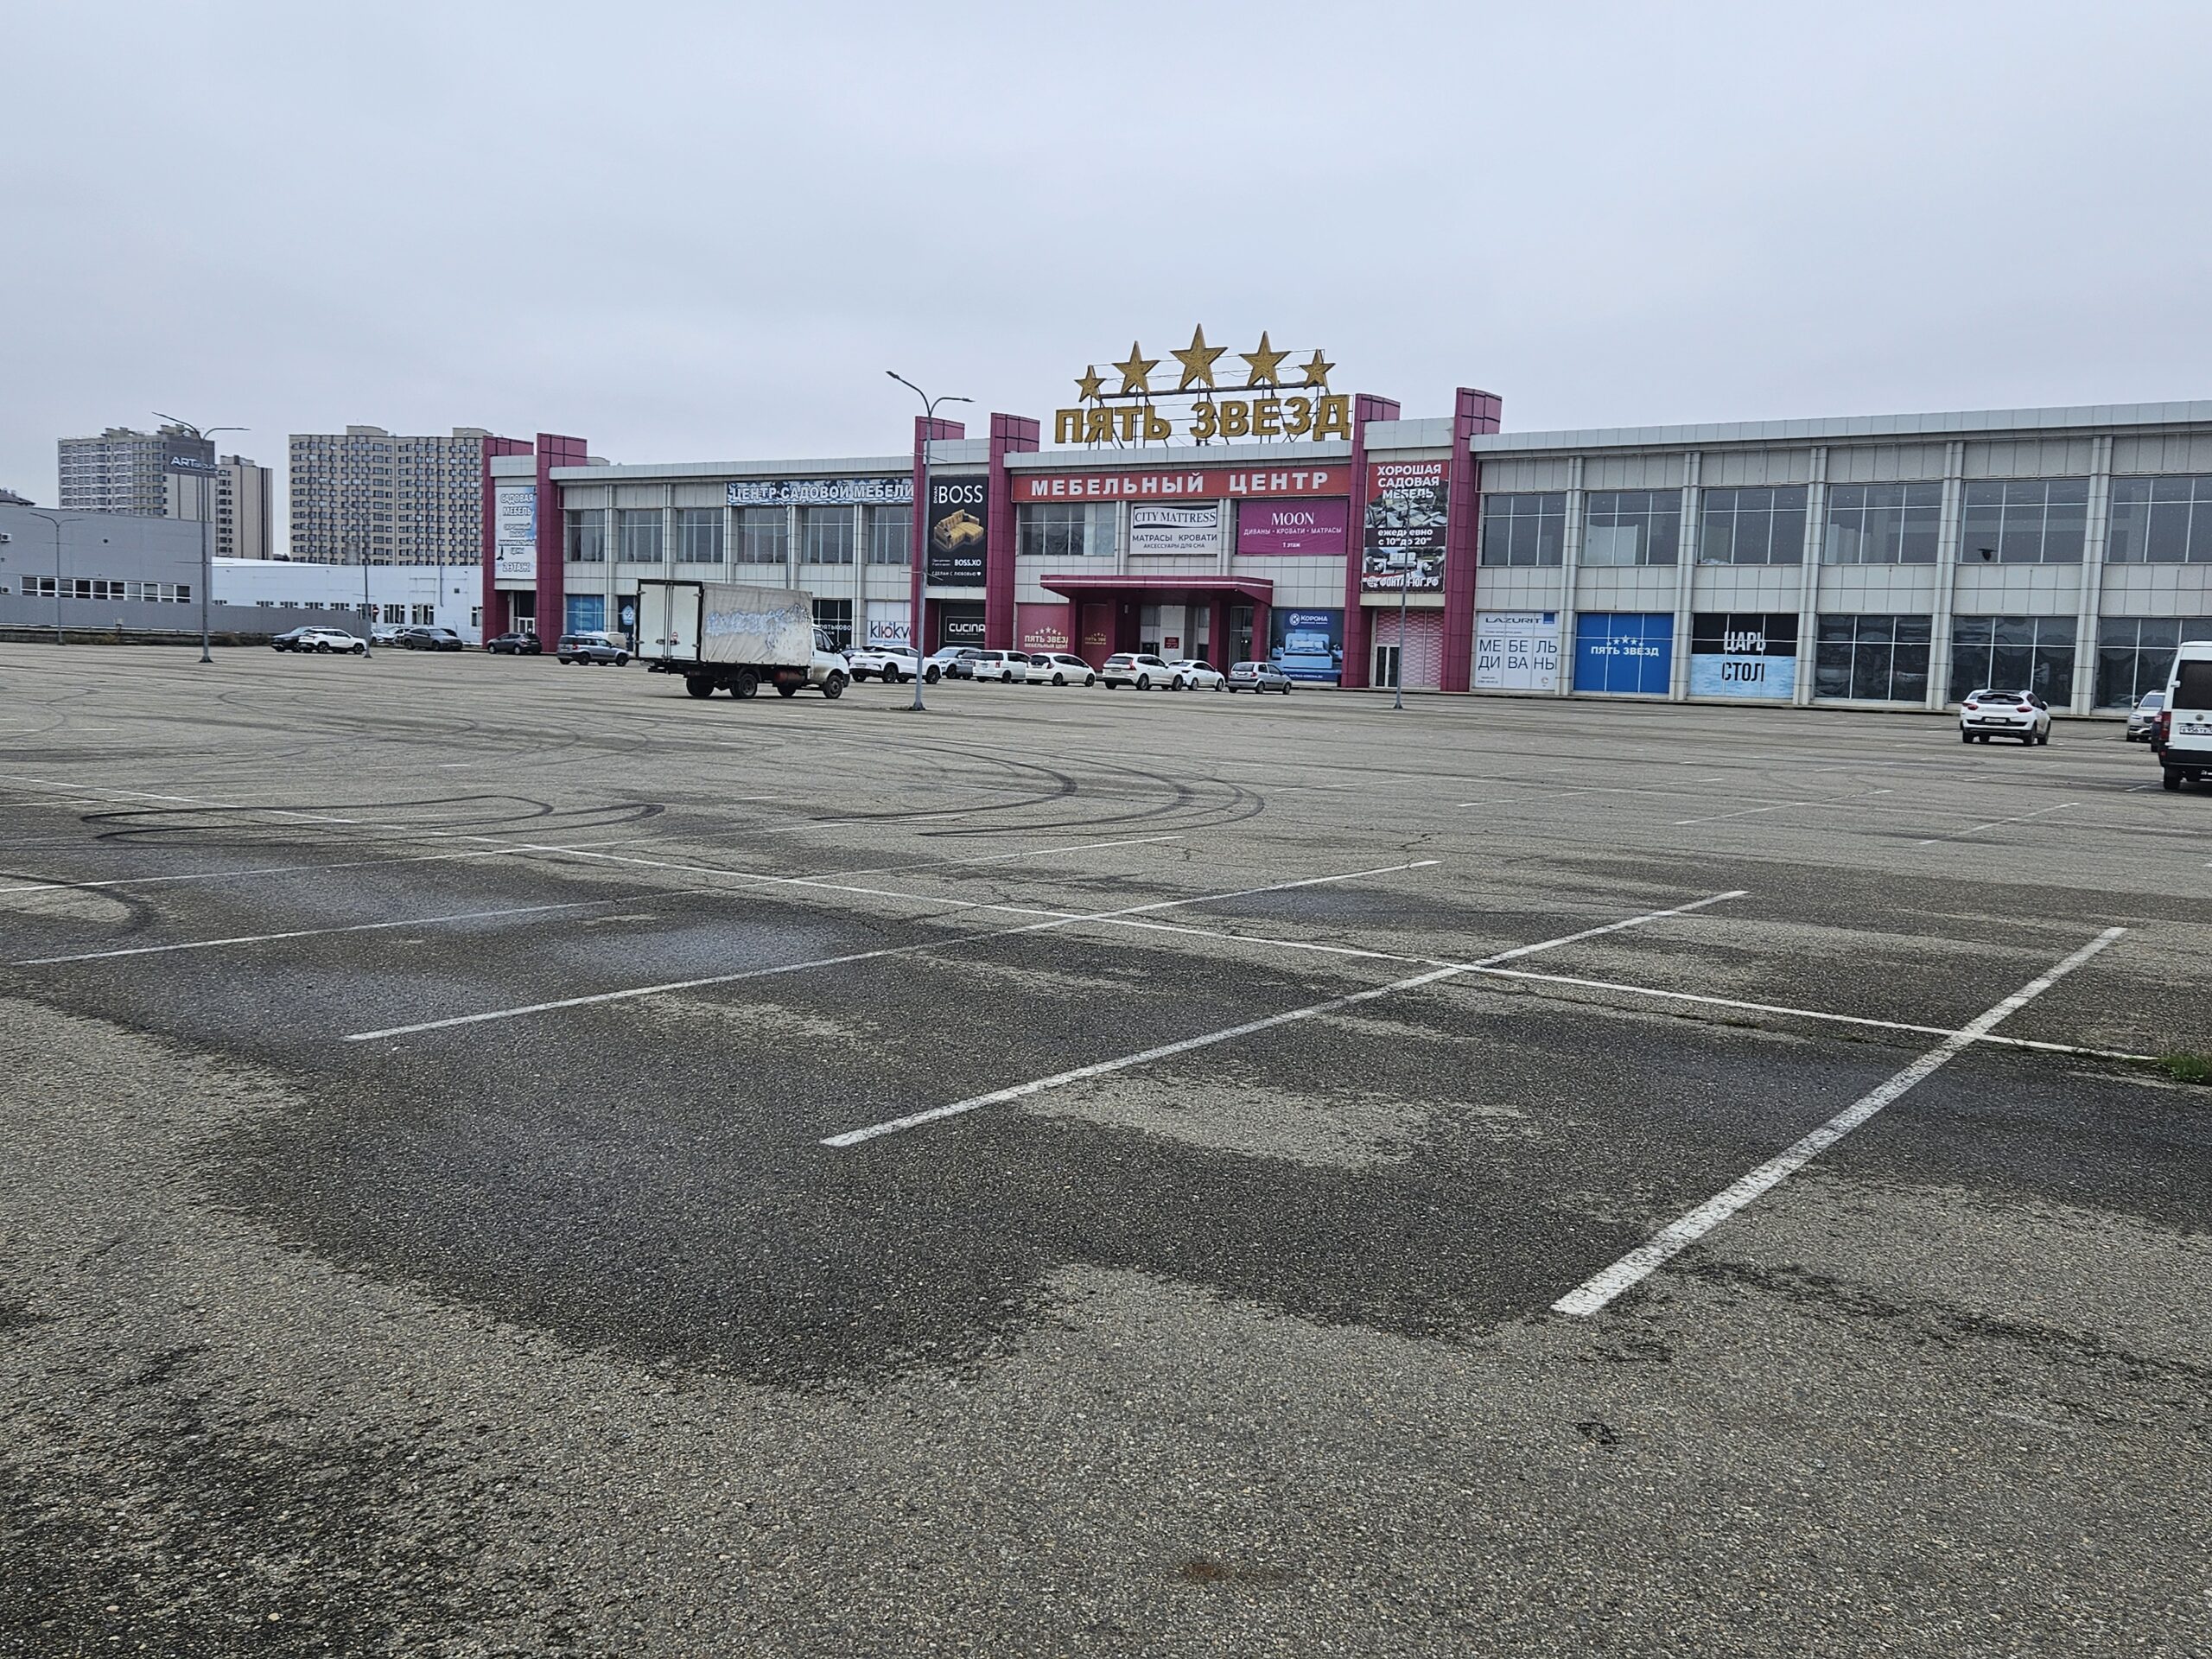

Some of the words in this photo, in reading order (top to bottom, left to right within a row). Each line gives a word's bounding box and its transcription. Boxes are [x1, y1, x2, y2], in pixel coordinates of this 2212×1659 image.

[1055, 404, 1172, 444] ПЯТЬ
[1189, 394, 1352, 442] ЗВЕЗД
[1377, 464, 1441, 476] ХОРОШАЯ
[1031, 472, 1204, 497] МЕБЕЛЬНЫЙ
[1229, 472, 1329, 495] ЦЕНТР
[1378, 476, 1440, 489] САДОВАЯ
[733, 487, 777, 502] ЦЕНТР
[780, 484, 849, 501] САДОВОЙ
[854, 483, 913, 499] МЕБЕЛИ
[938, 485, 983, 504] BOSS
[1382, 489, 1434, 499] МЕБЕЛЬ
[500, 493, 533, 505] САДОВАЯ
[503, 506, 532, 516] МЕБЕЛЬ
[1135, 512, 1158, 522] CITY
[1160, 512, 1216, 523] MATTRESS
[1271, 512, 1314, 525] MOON
[1178, 533, 1217, 542] КРОВАТИ
[949, 623, 986, 632] CUCINA
[1724, 632, 1766, 652] ЦАРЬ
[1591, 646, 1620, 655] ПЯТЬ
[1623, 647, 1659, 657] ЗВЕЗД
[1722, 662, 1764, 682] СТОЛ
